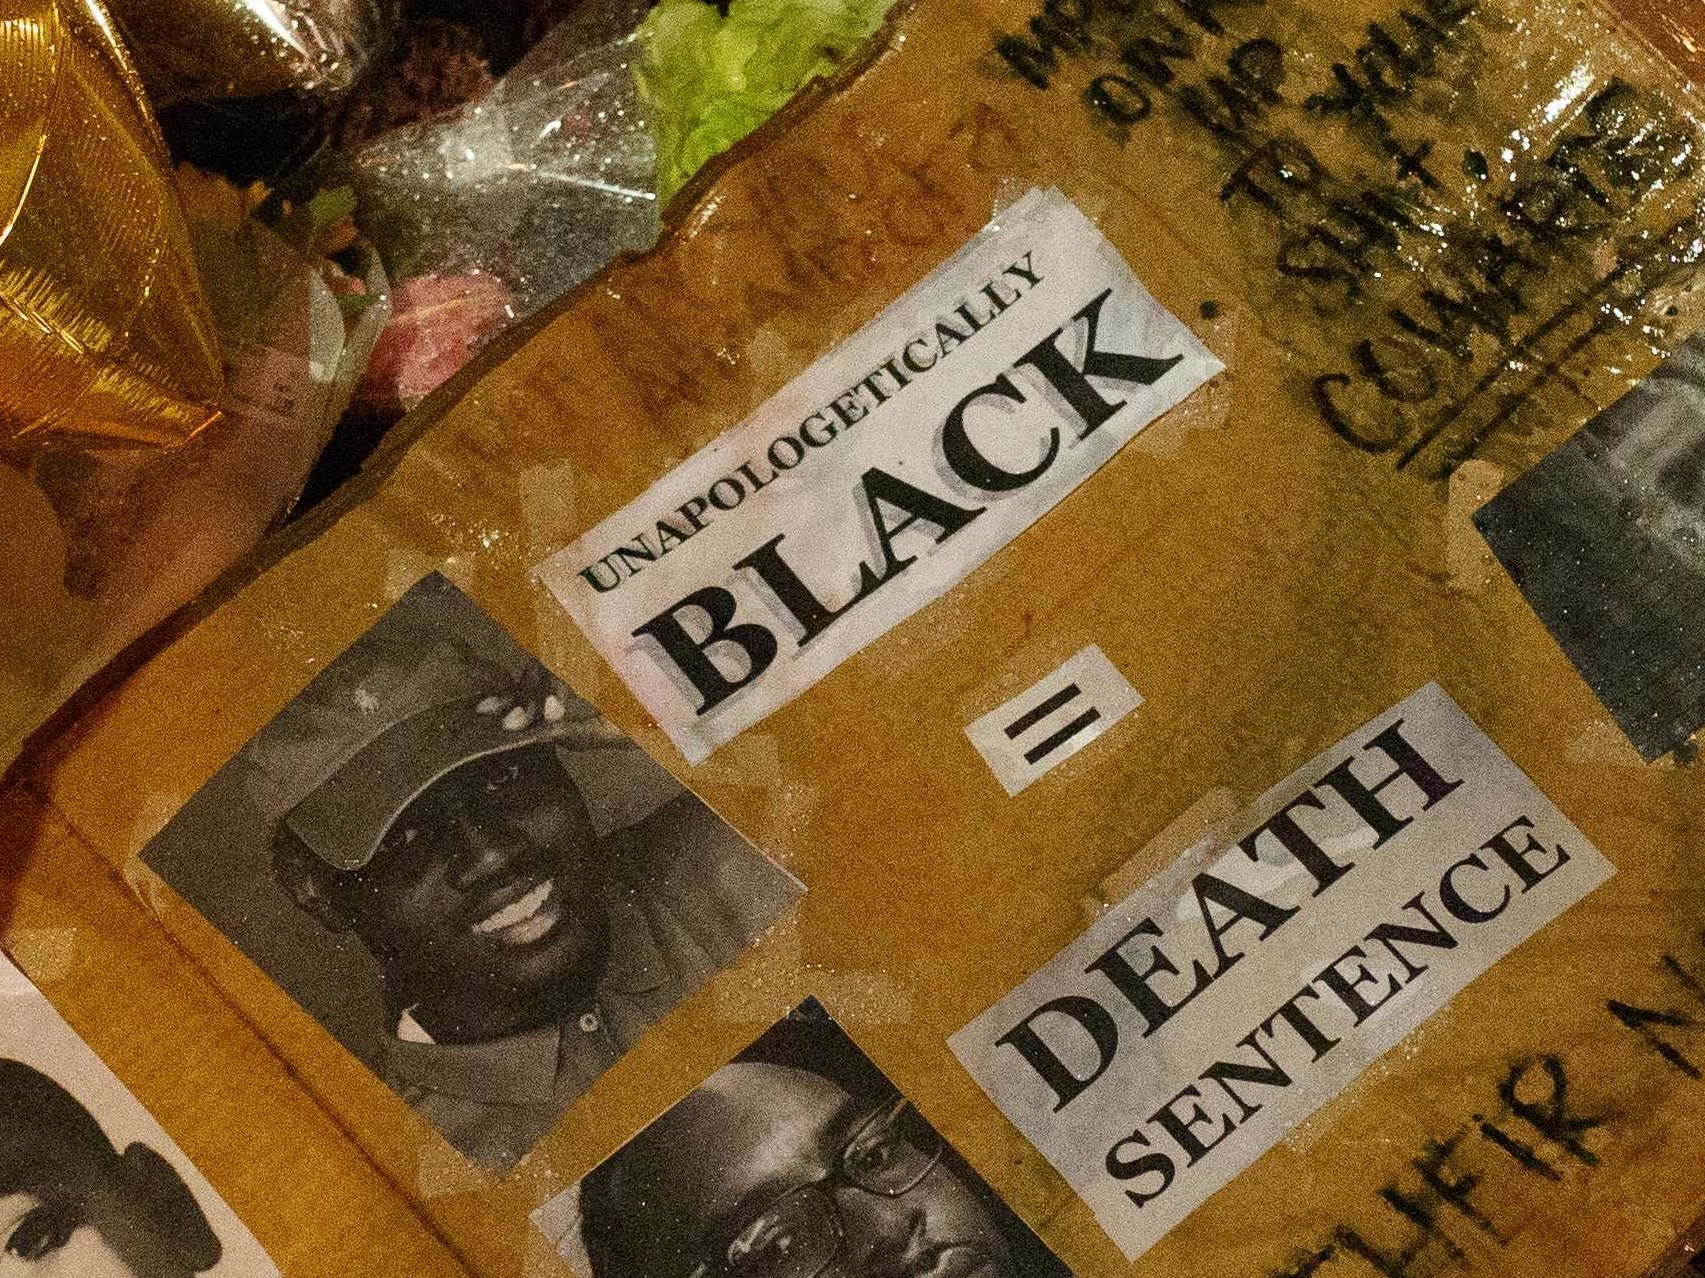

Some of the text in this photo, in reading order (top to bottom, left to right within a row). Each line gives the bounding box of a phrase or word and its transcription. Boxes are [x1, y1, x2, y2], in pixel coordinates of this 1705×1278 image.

[578, 249, 1047, 596] UNAPOLOGETICALLY
[630, 288, 1184, 719] BLACK
[994, 720, 1464, 1114] DEATH
[1102, 815, 1571, 1208] SENTENCE
